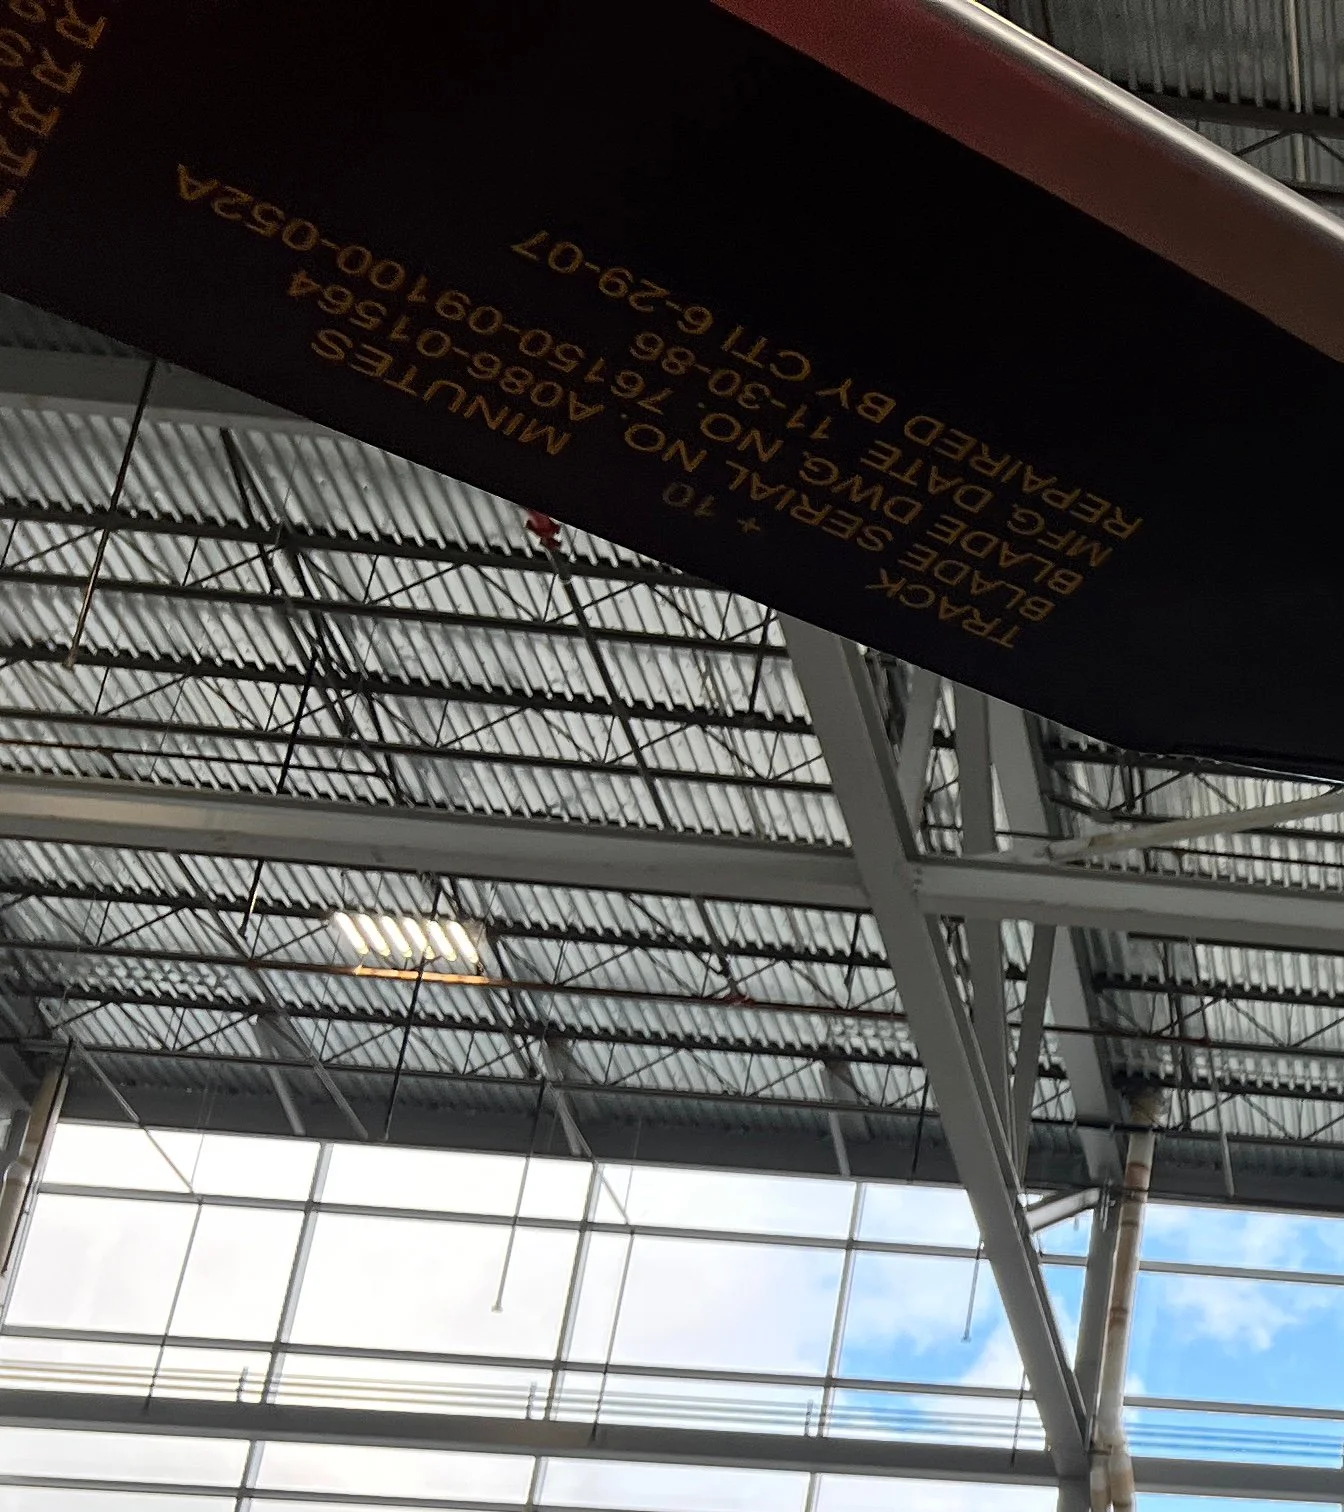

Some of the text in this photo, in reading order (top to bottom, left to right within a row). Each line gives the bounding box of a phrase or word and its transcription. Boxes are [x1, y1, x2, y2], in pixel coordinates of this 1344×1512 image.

[177, 164, 672, 414] 76150-09100-052A
[287, 271, 1055, 622] BLADE SERIAL NO. A086-01564
[310, 330, 572, 457] MINUTES
[511, 230, 1145, 541] REPAIRED BY CTI 6-29-07
[698, 402, 784, 463] NO.
[630, 332, 1114, 569] MFG. DATE 11-30-86
[662, 480, 715, 518] 10
[866, 568, 1020, 650] TRACK
[926, 514, 1085, 596] BLADE
